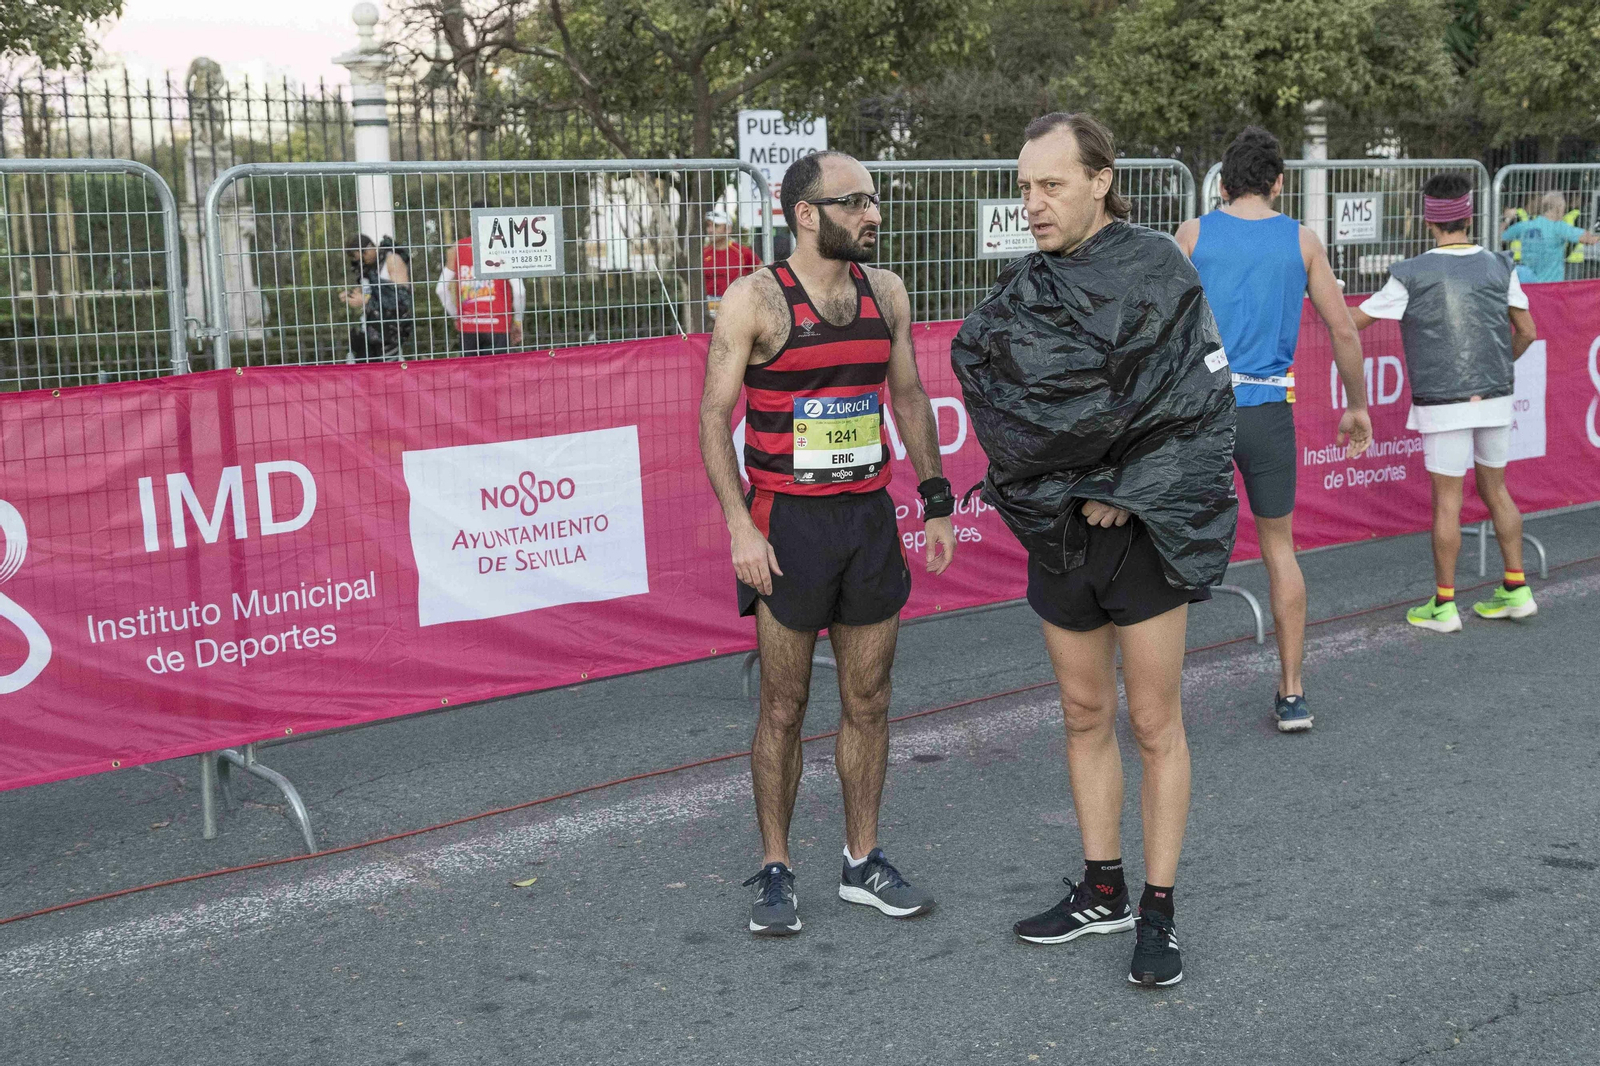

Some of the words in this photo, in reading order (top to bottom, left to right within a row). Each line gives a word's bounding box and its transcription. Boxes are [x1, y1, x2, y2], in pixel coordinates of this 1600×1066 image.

[747, 118, 815, 136] PUESTO
[1341, 199, 1372, 222] AMS
[488, 216, 547, 249] AMS
[826, 399, 870, 415] ZURICH
[826, 428, 857, 444] 1241
[831, 452, 855, 465] ERIC
[1324, 470, 1344, 490] de
[1346, 464, 1407, 488] Deportes
[138, 460, 317, 553] IMD
[452, 514, 609, 550] AYUNTAMIENTO
[478, 556, 508, 574] DE
[515, 545, 587, 571] SEVILLA
[87, 601, 221, 643] Instituto
[231, 570, 377, 620] Municipal
[146, 647, 185, 674] de
[195, 622, 337, 667] Deportes
